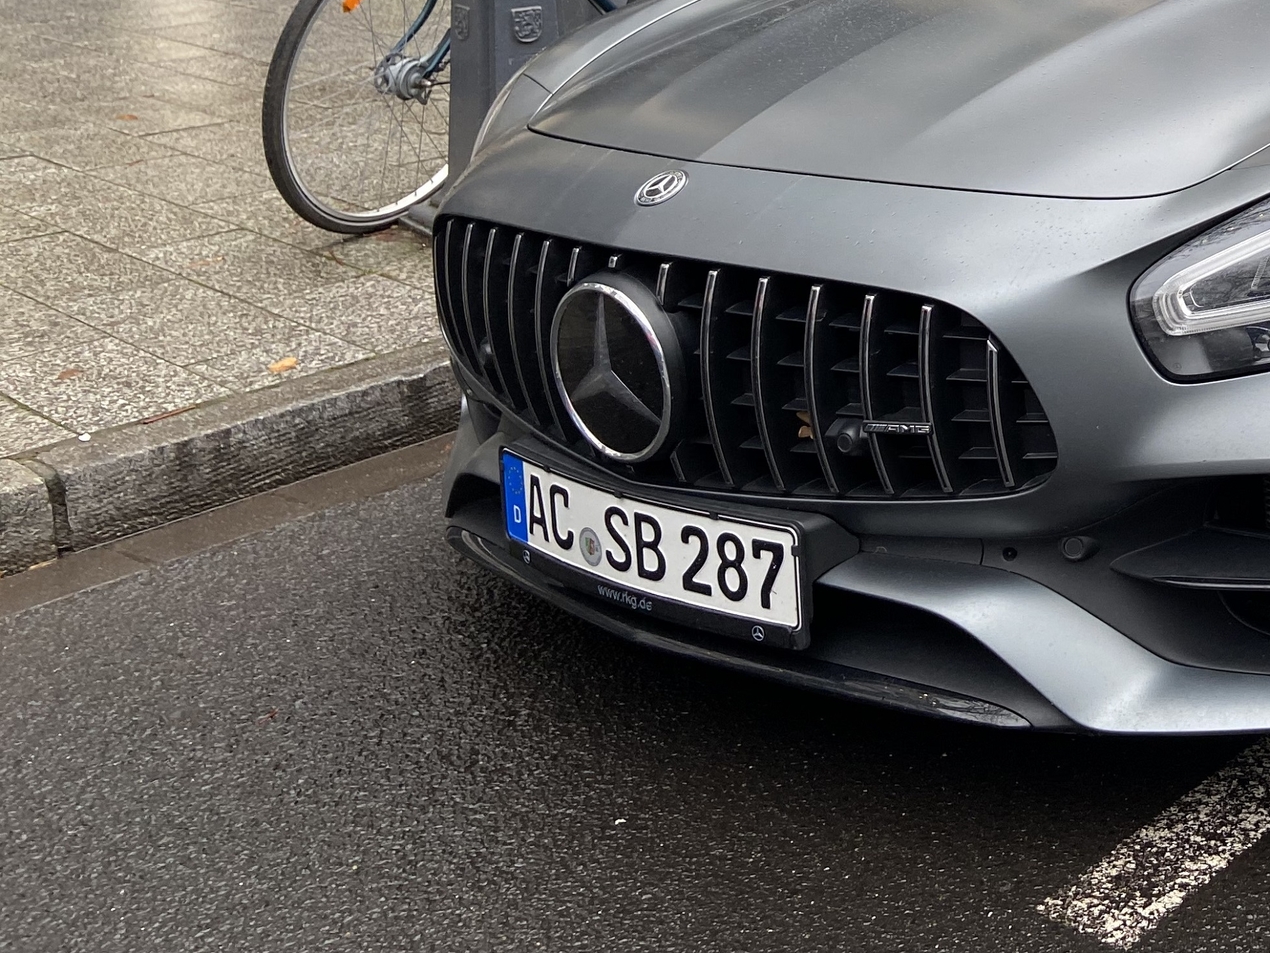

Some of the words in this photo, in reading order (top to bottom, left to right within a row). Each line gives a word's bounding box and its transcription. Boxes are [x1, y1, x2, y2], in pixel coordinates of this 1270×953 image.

[513, 504, 522, 523] D
[528, 473, 575, 550] AC
[604, 505, 667, 582] SB
[680, 524, 785, 610] 287
[597, 584, 653, 612] www.rkg.de
